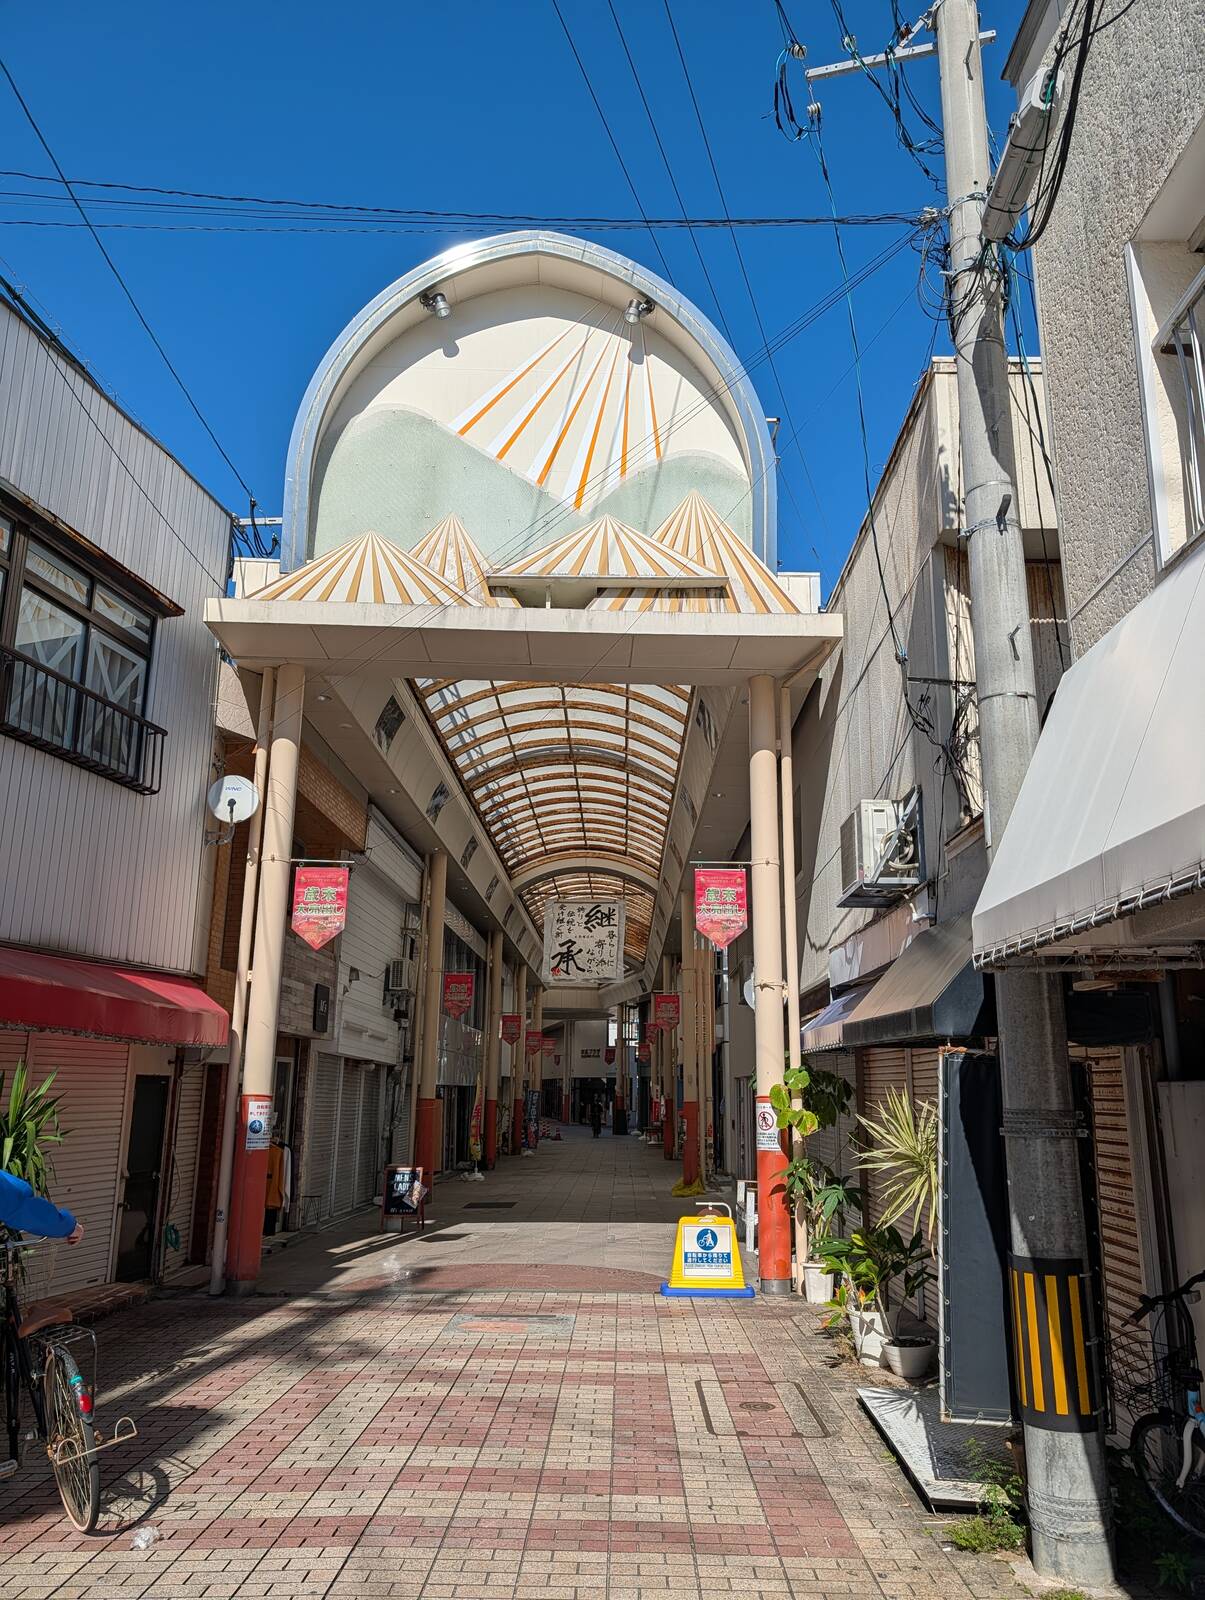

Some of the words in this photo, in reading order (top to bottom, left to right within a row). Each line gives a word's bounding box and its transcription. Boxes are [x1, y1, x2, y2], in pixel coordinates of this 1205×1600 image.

[304, 886, 337, 902] 歳末
[705, 887, 737, 902] 歳末
[295, 903, 344, 915] 大売出し
[697, 904, 745, 916] 大売出し
[584, 904, 617, 933] 継
[551, 939, 586, 975] 承
